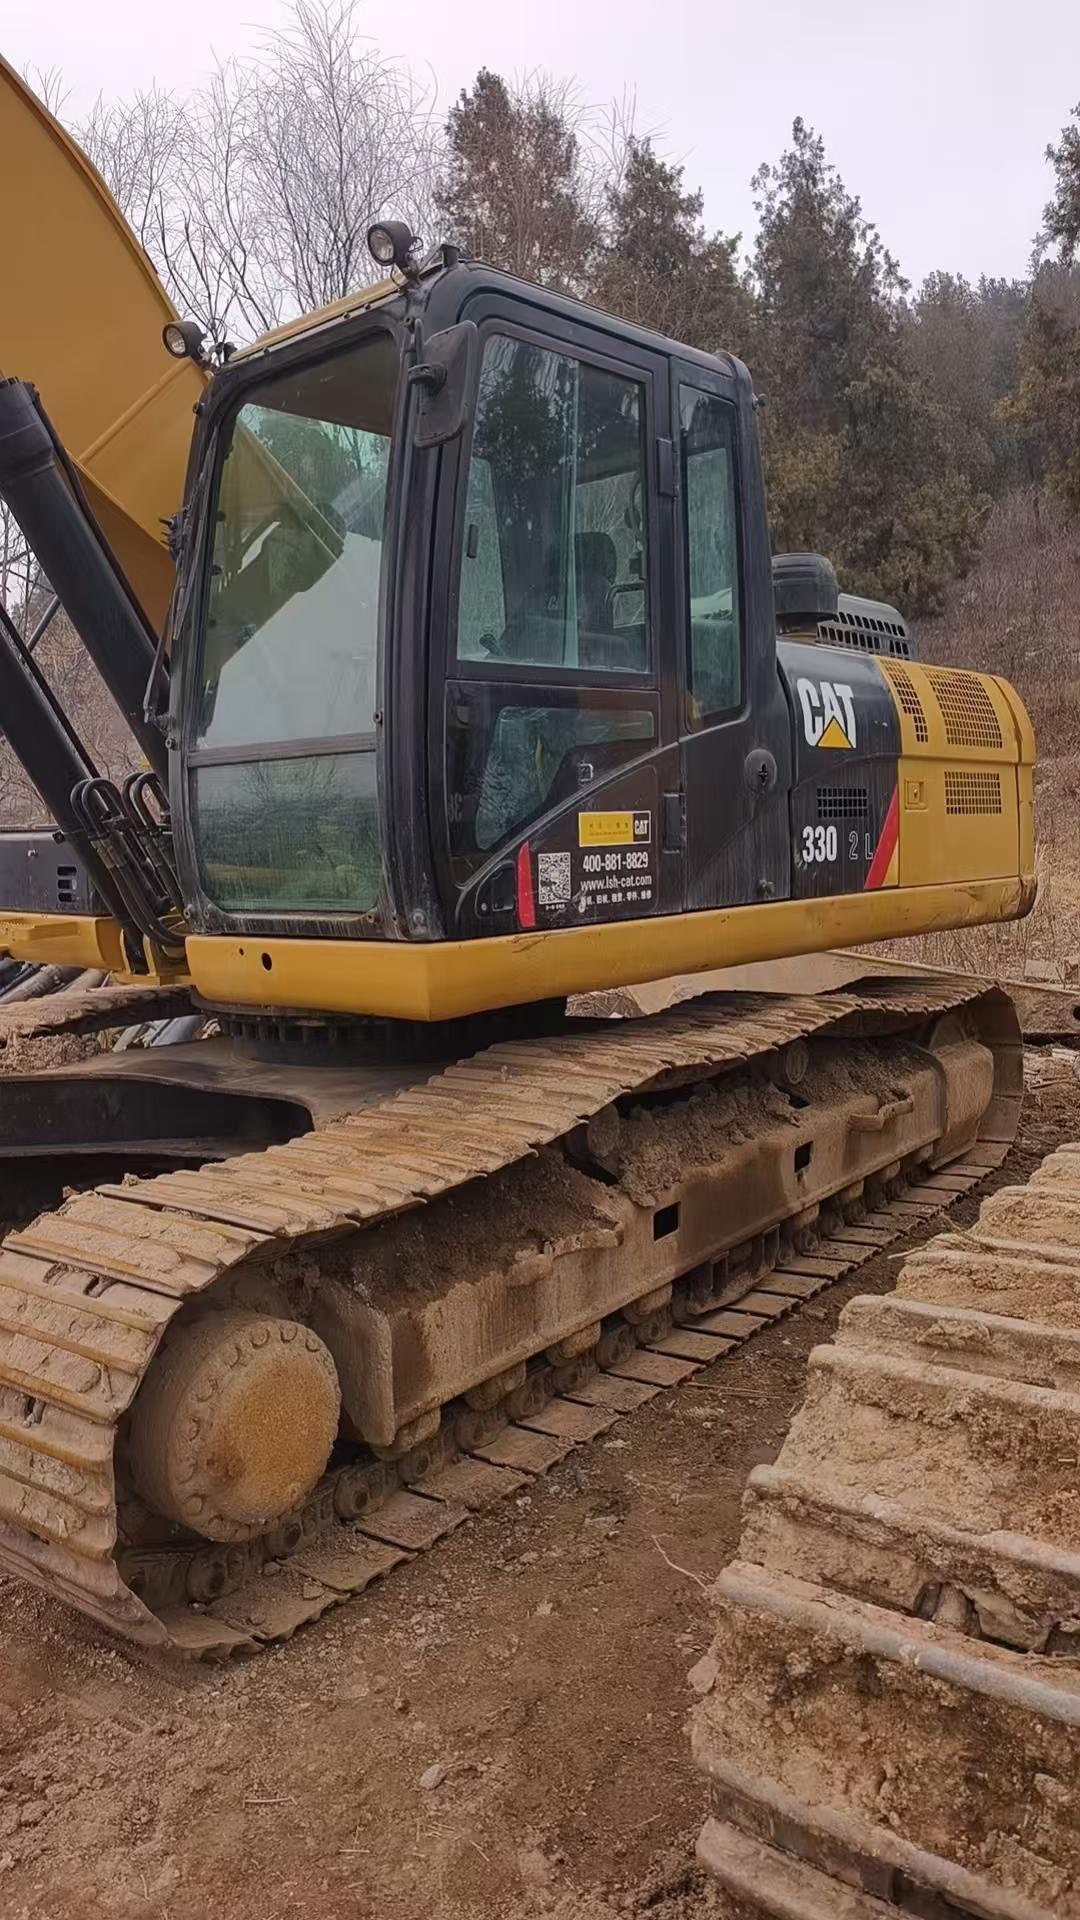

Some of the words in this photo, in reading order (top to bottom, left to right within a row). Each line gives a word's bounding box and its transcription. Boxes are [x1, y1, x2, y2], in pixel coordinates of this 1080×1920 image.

[797, 678, 856, 748] CAT
[634, 820, 648, 834] CAT
[802, 825, 837, 862] 330
[848, 830, 859, 860] 2
[582, 851, 649, 872] 400-881-8829
[580, 875, 652, 891] www.lsh-cat.com
